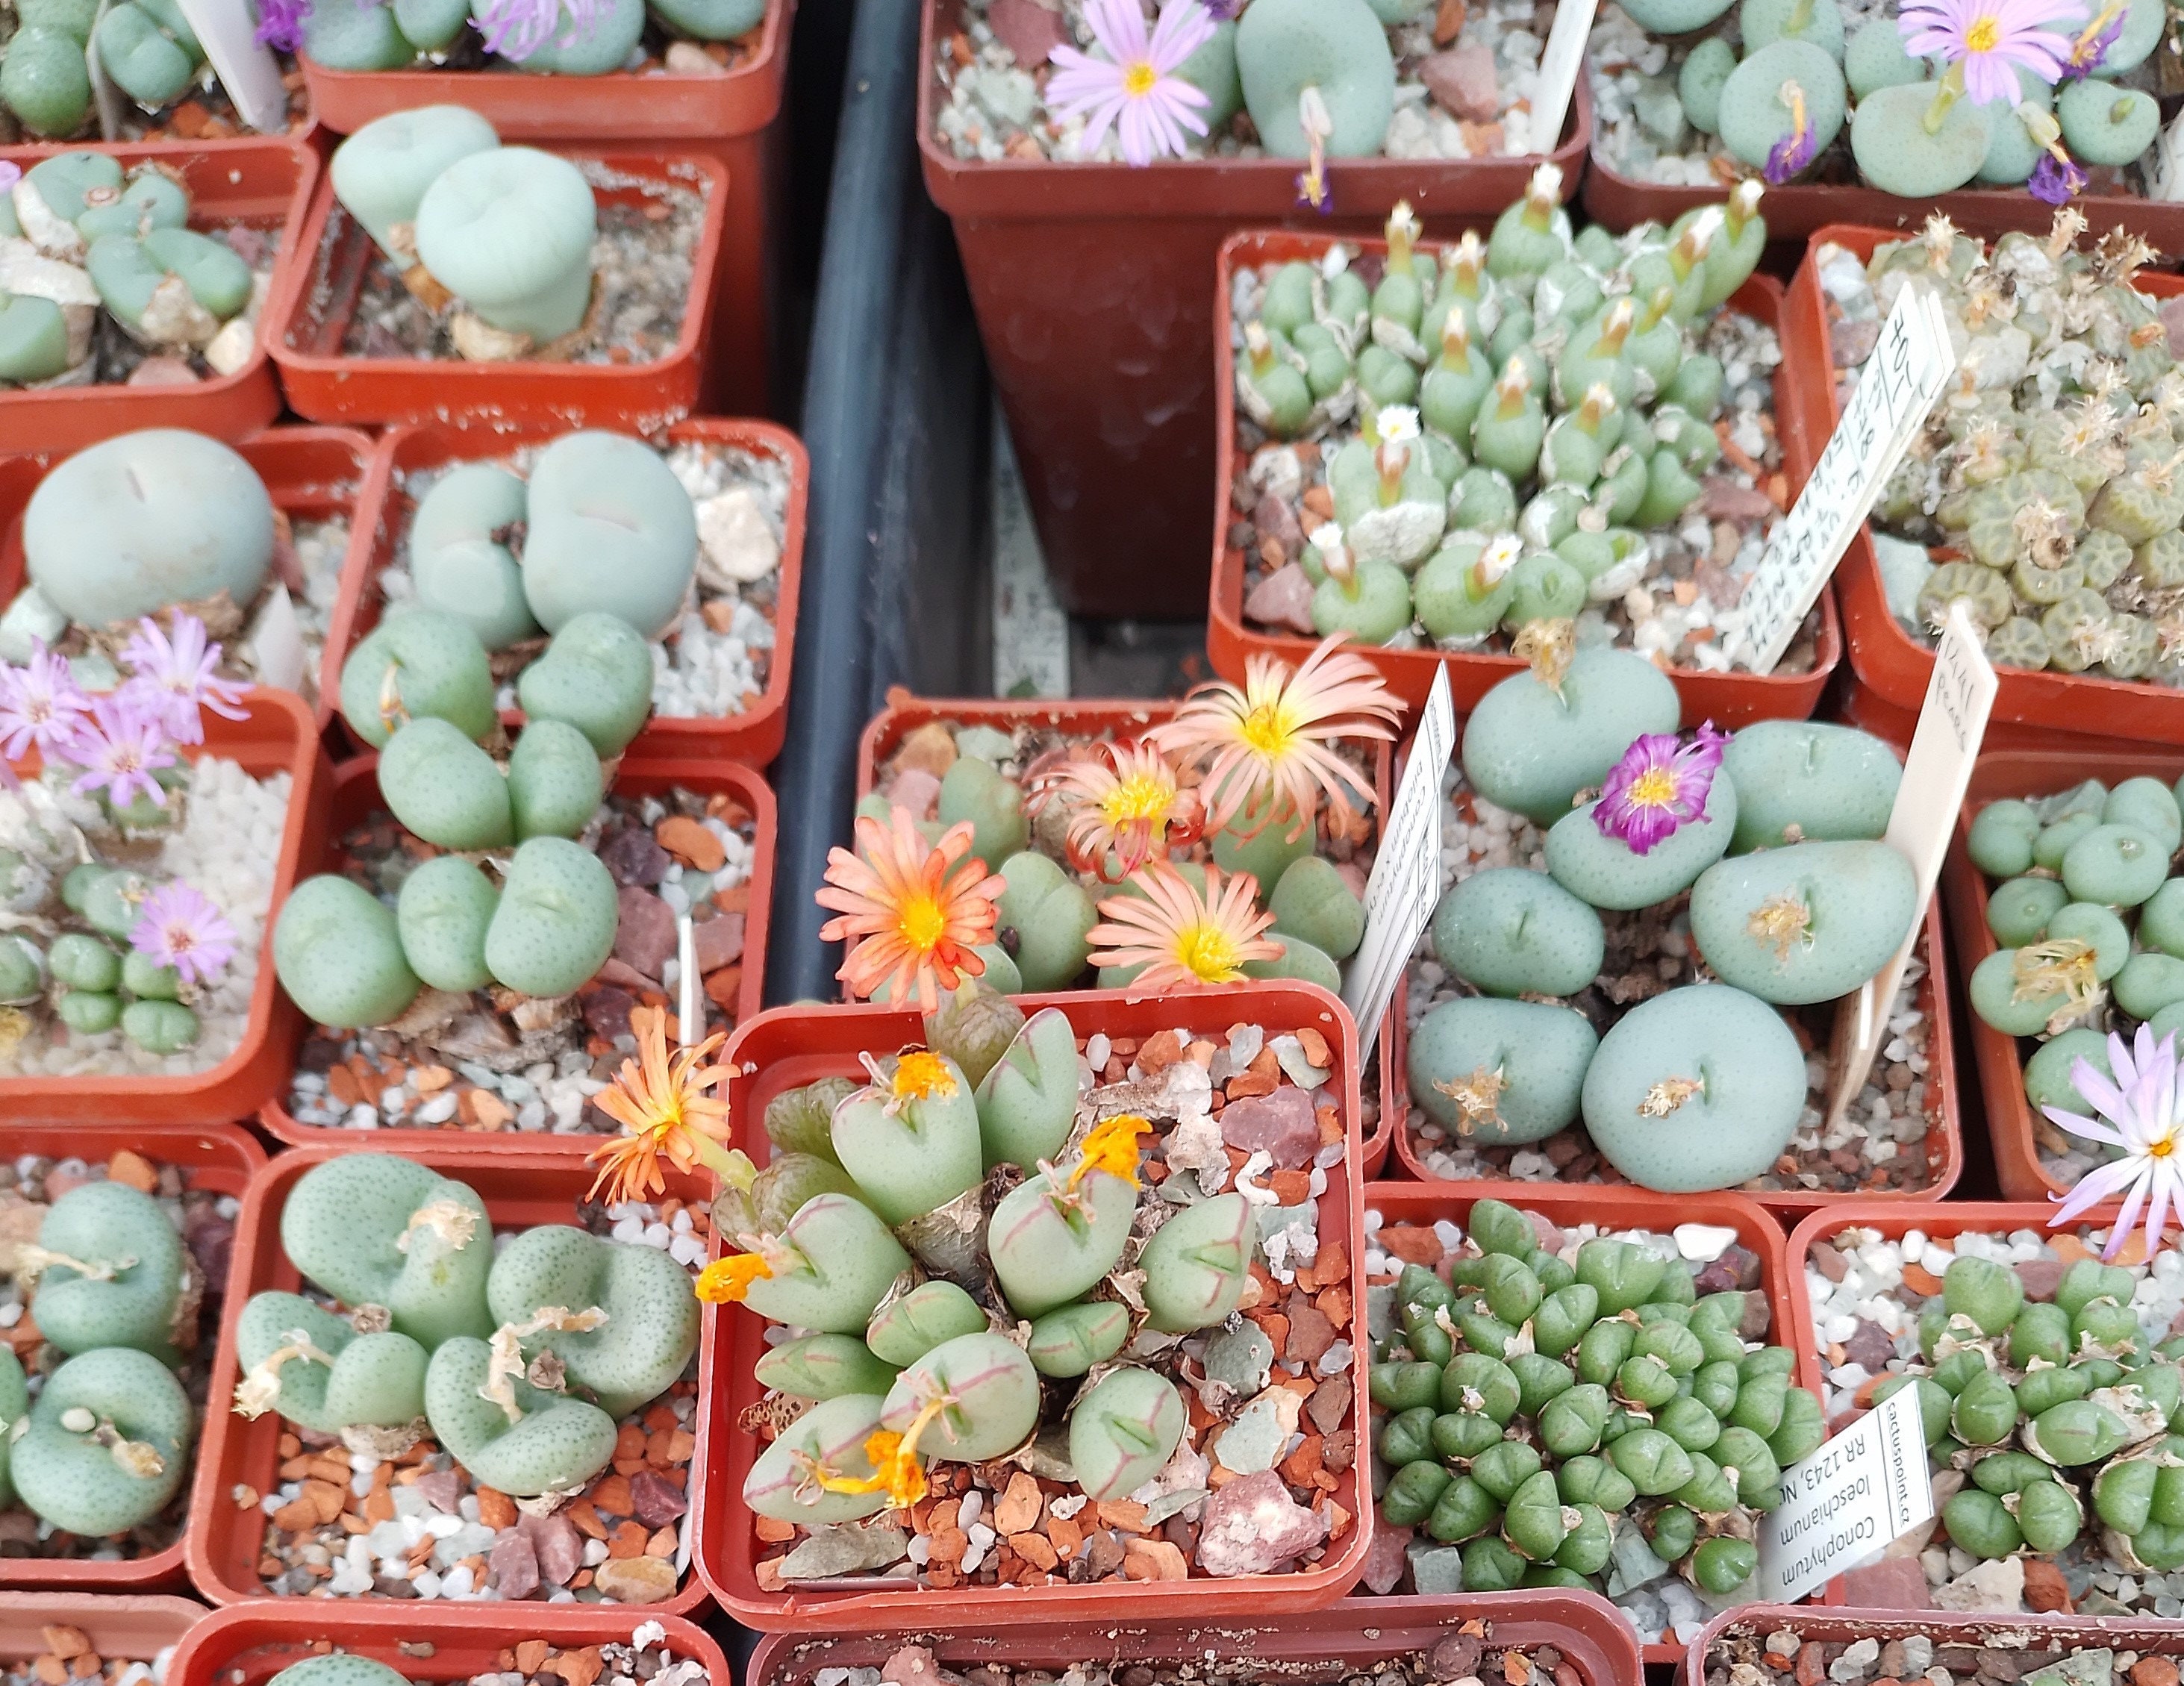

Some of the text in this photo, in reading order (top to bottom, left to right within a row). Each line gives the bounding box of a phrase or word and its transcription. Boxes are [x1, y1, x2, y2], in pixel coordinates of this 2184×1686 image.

[1391, 759, 1423, 852] bilobum
[1377, 785, 1426, 925] Conophytum
[1800, 1450, 1841, 1491] 1243,
[1845, 1433, 1866, 1463] RR
[1887, 1401, 1909, 1524] cactuspoint.cz
[1780, 1474, 1871, 1546] loeschianum
[1781, 1516, 1875, 1586] Conophytum
